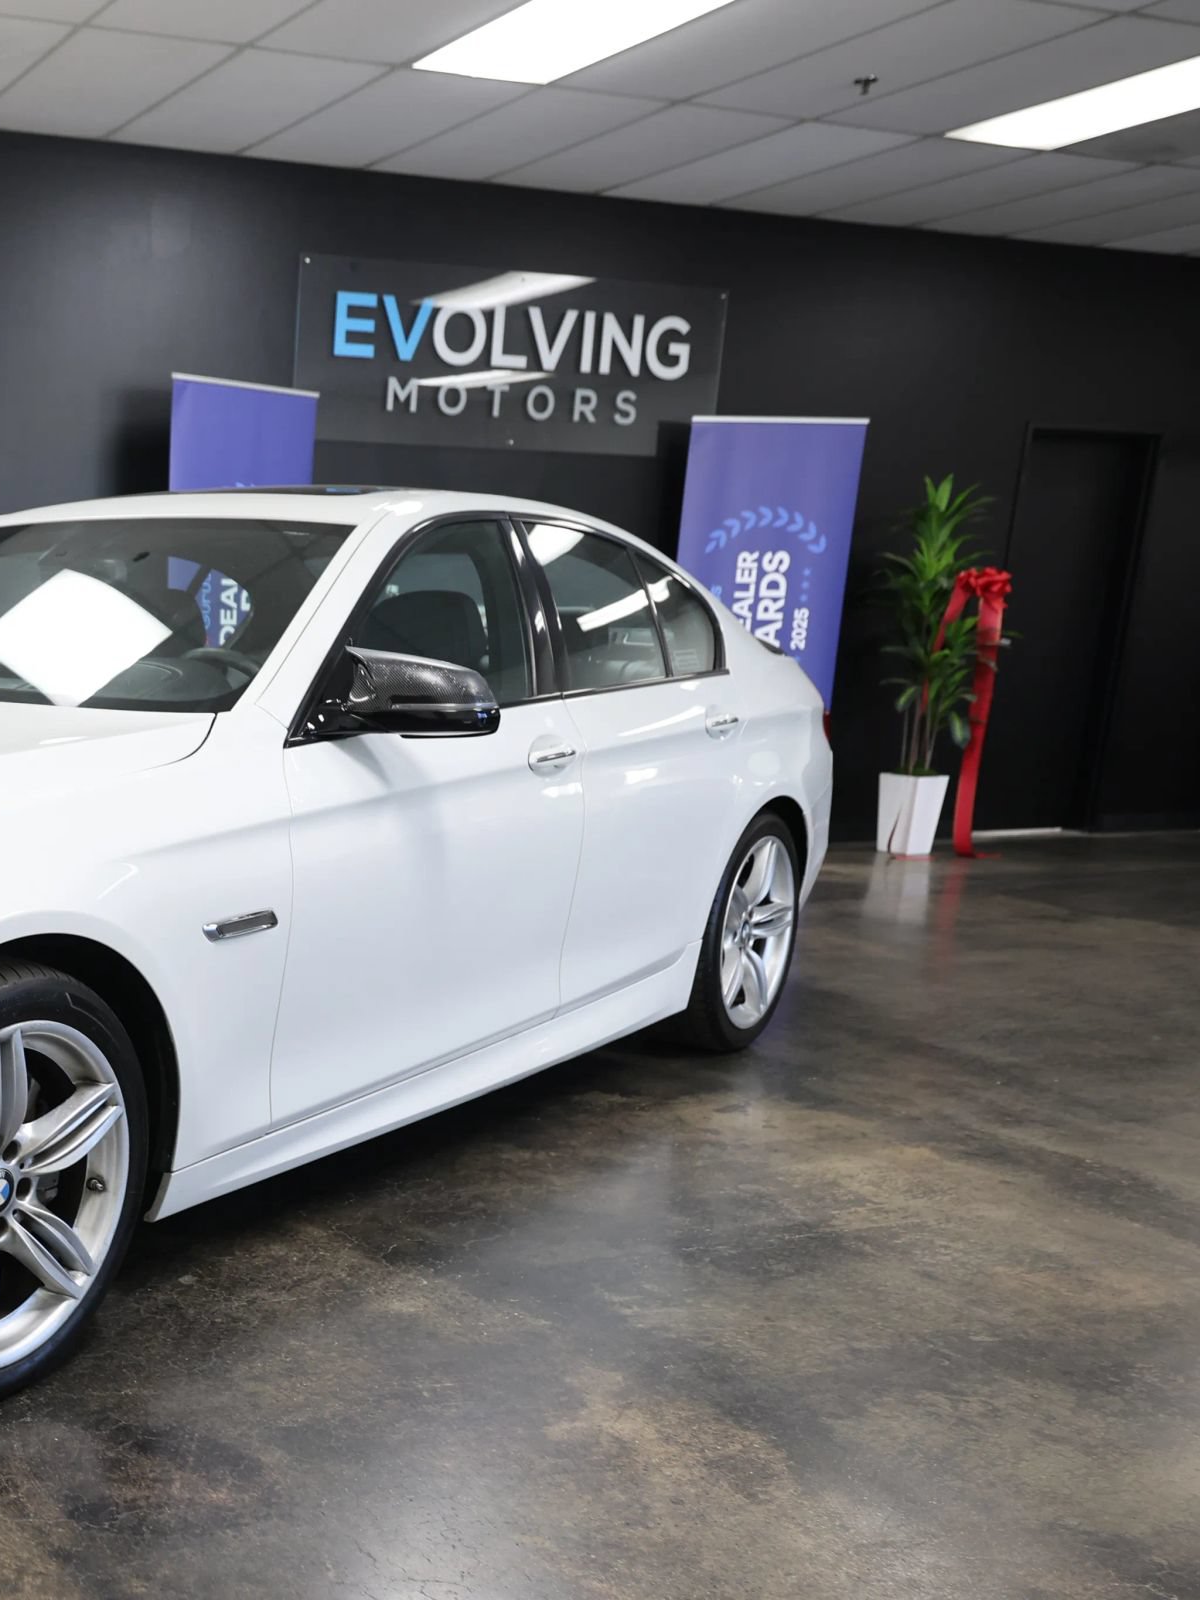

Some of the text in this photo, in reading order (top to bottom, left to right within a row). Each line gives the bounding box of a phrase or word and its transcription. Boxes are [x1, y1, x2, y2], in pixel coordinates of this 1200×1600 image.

[333, 290, 691, 380] EVOLVING
[385, 376, 638, 425] MOTORS
[791, 608, 809, 650] 2025
